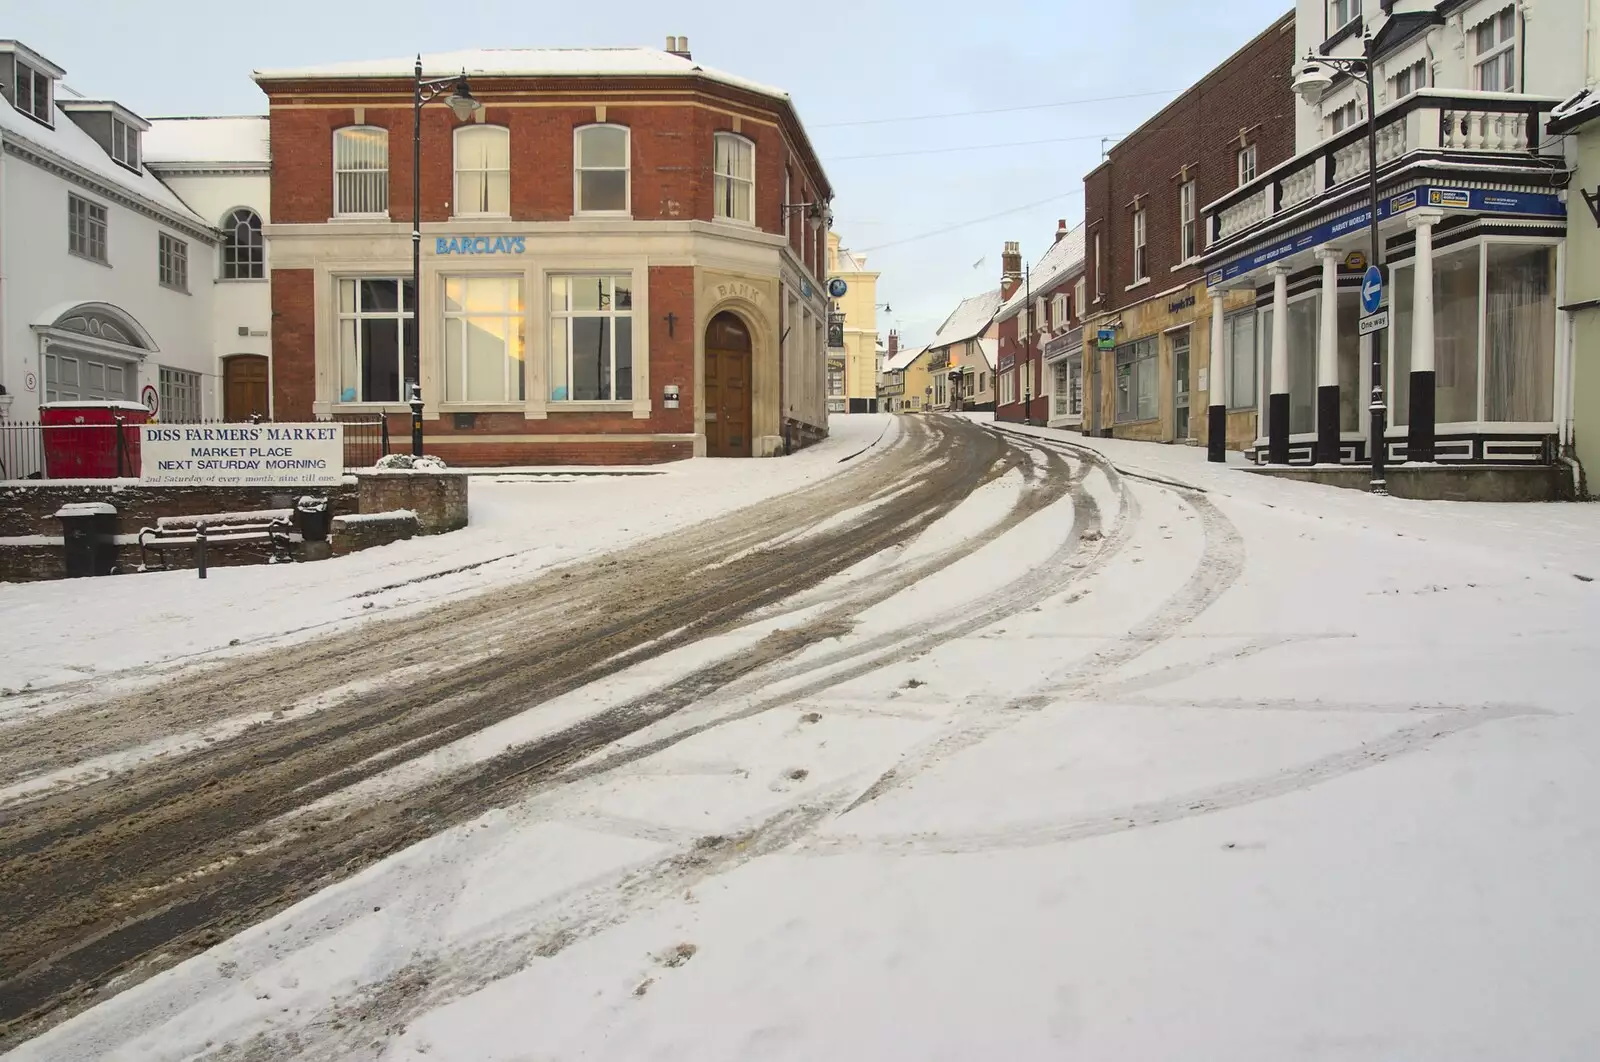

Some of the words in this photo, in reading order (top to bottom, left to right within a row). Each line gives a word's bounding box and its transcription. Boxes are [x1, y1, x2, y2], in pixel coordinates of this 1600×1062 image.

[1331, 220, 1348, 233] HARVEY
[1348, 213, 1365, 226] WORLD
[1365, 207, 1382, 220] TREL
[436, 236, 526, 255] BARCLAYS
[717, 283, 760, 303] BANK
[1361, 320, 1373, 330] One
[1374, 316, 1386, 326] way
[147, 429, 181, 441] DISS
[267, 428, 337, 441] MARKET
[191, 447, 247, 457] MARKET
[250, 447, 293, 457] PLACE
[158, 460, 193, 470] NEXT
[197, 460, 261, 470] SATURDAY
[265, 459, 327, 470] MORNING
[145, 475, 161, 483] 2nd
[164, 475, 203, 484] Saturday
[206, 475, 216, 483] of
[219, 476, 242, 484] every
[279, 474, 298, 482] nine
[302, 473, 316, 482] till
